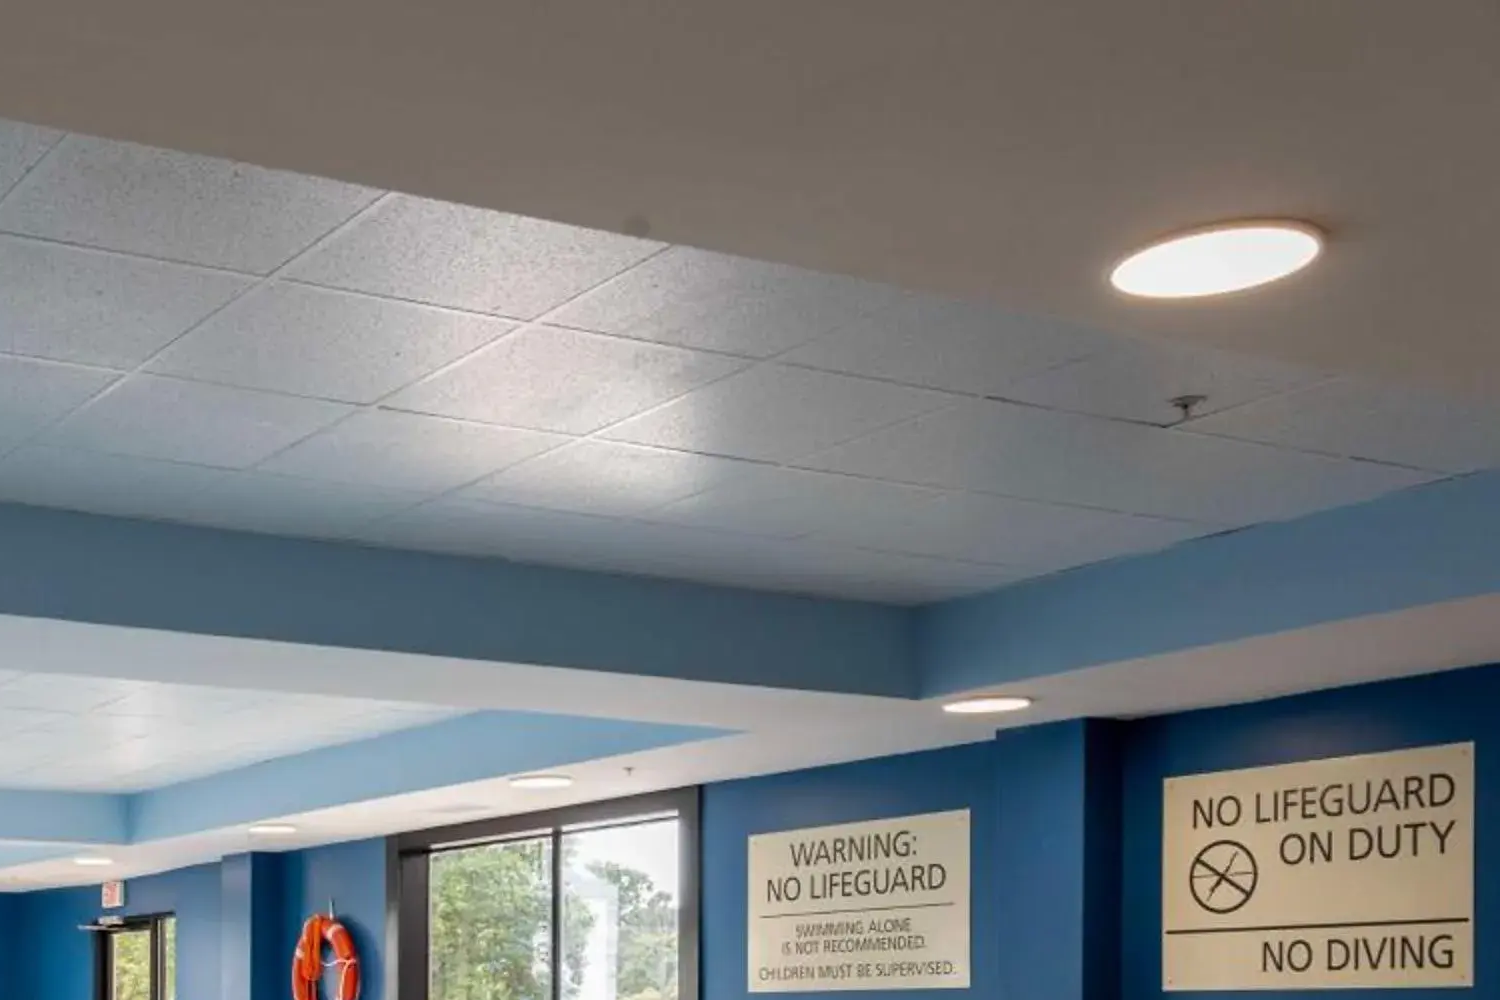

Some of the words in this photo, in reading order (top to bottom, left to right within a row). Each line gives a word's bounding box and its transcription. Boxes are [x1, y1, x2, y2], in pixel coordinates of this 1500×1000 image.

[1192, 796, 1241, 829] NO
[1255, 773, 1455, 824] LIFEGUARD
[790, 830, 917, 867] WARNING:
[1279, 831, 1333, 865] ON
[1349, 819, 1456, 861] DUTY
[767, 877, 800, 902] NO
[810, 864, 947, 899] LIFEGUARD
[795, 921, 863, 938] SWIMMING
[869, 918, 911, 933] ALONE
[781, 942, 791, 956] IS
[795, 941, 819, 955] NOT
[1262, 939, 1313, 972] NO
[1327, 934, 1454, 971] DIVING
[759, 966, 815, 981] CHILDREN
[818, 963, 852, 979] MUST
[857, 963, 871, 977] BE
